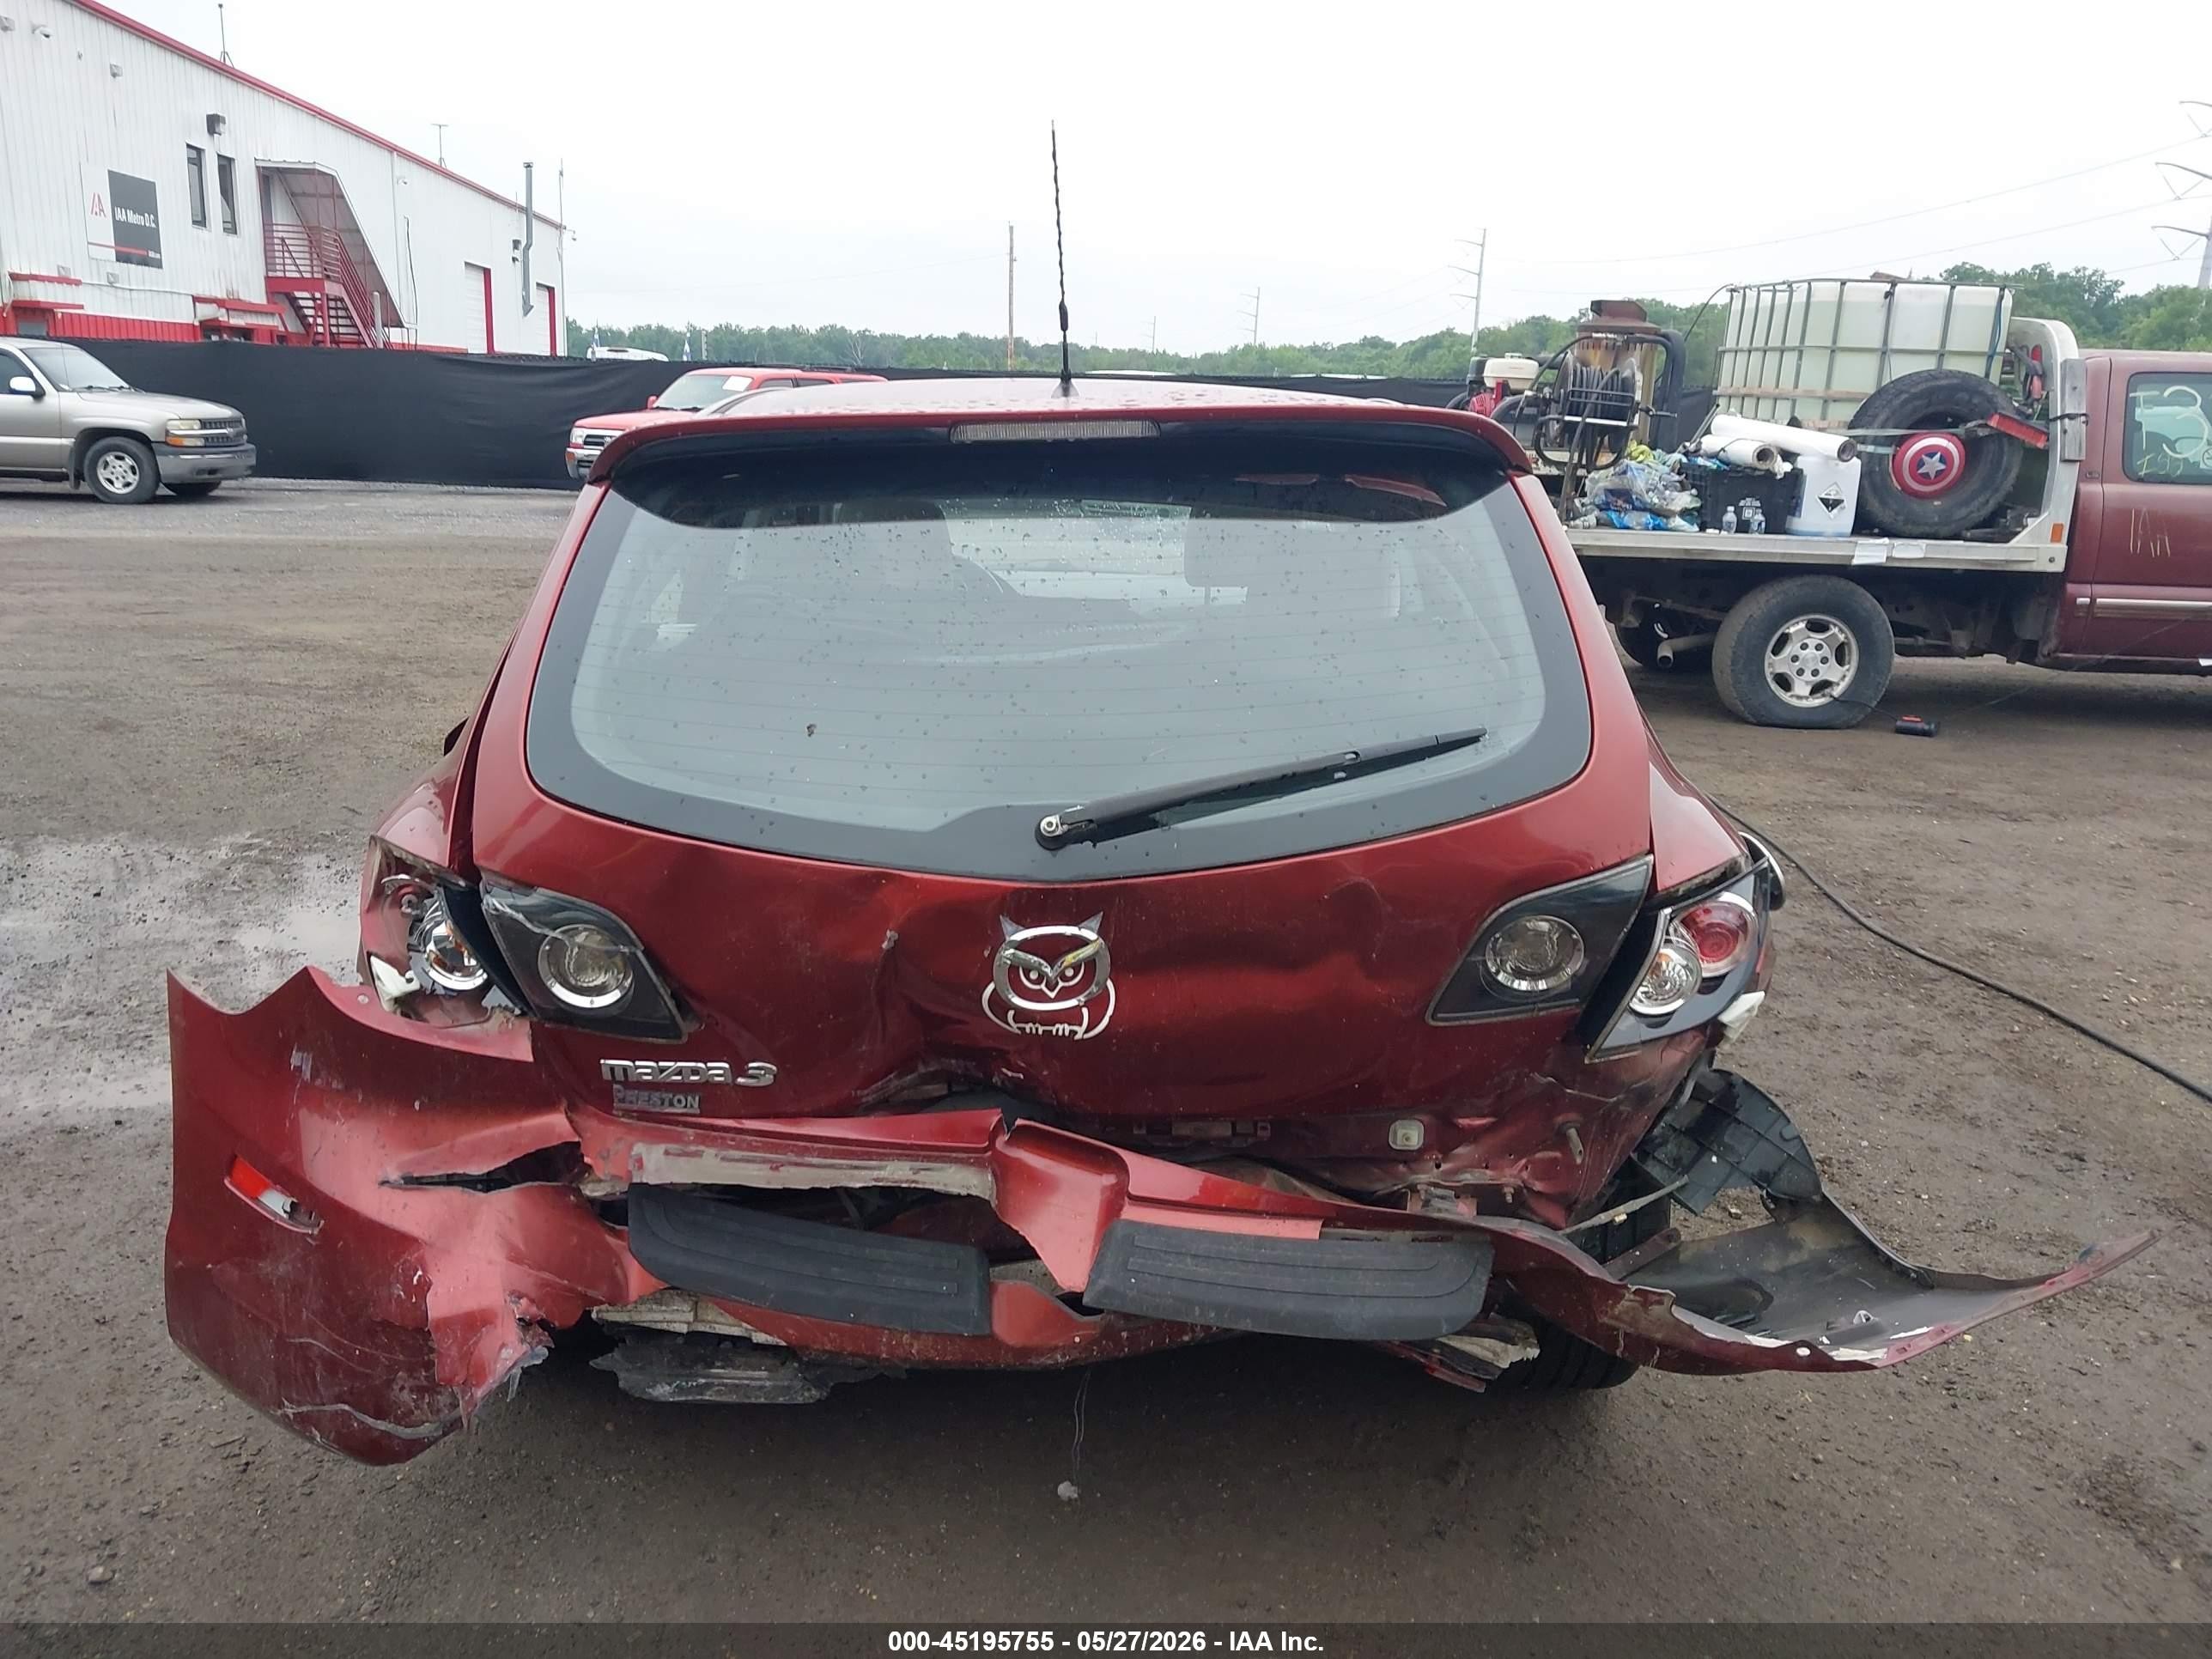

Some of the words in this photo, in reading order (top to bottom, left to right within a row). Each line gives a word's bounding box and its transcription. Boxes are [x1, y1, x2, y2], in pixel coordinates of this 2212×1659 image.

[114, 206, 127, 222] IAA
[127, 209, 145, 227] Metro
[144, 213, 157, 228] D.C.
